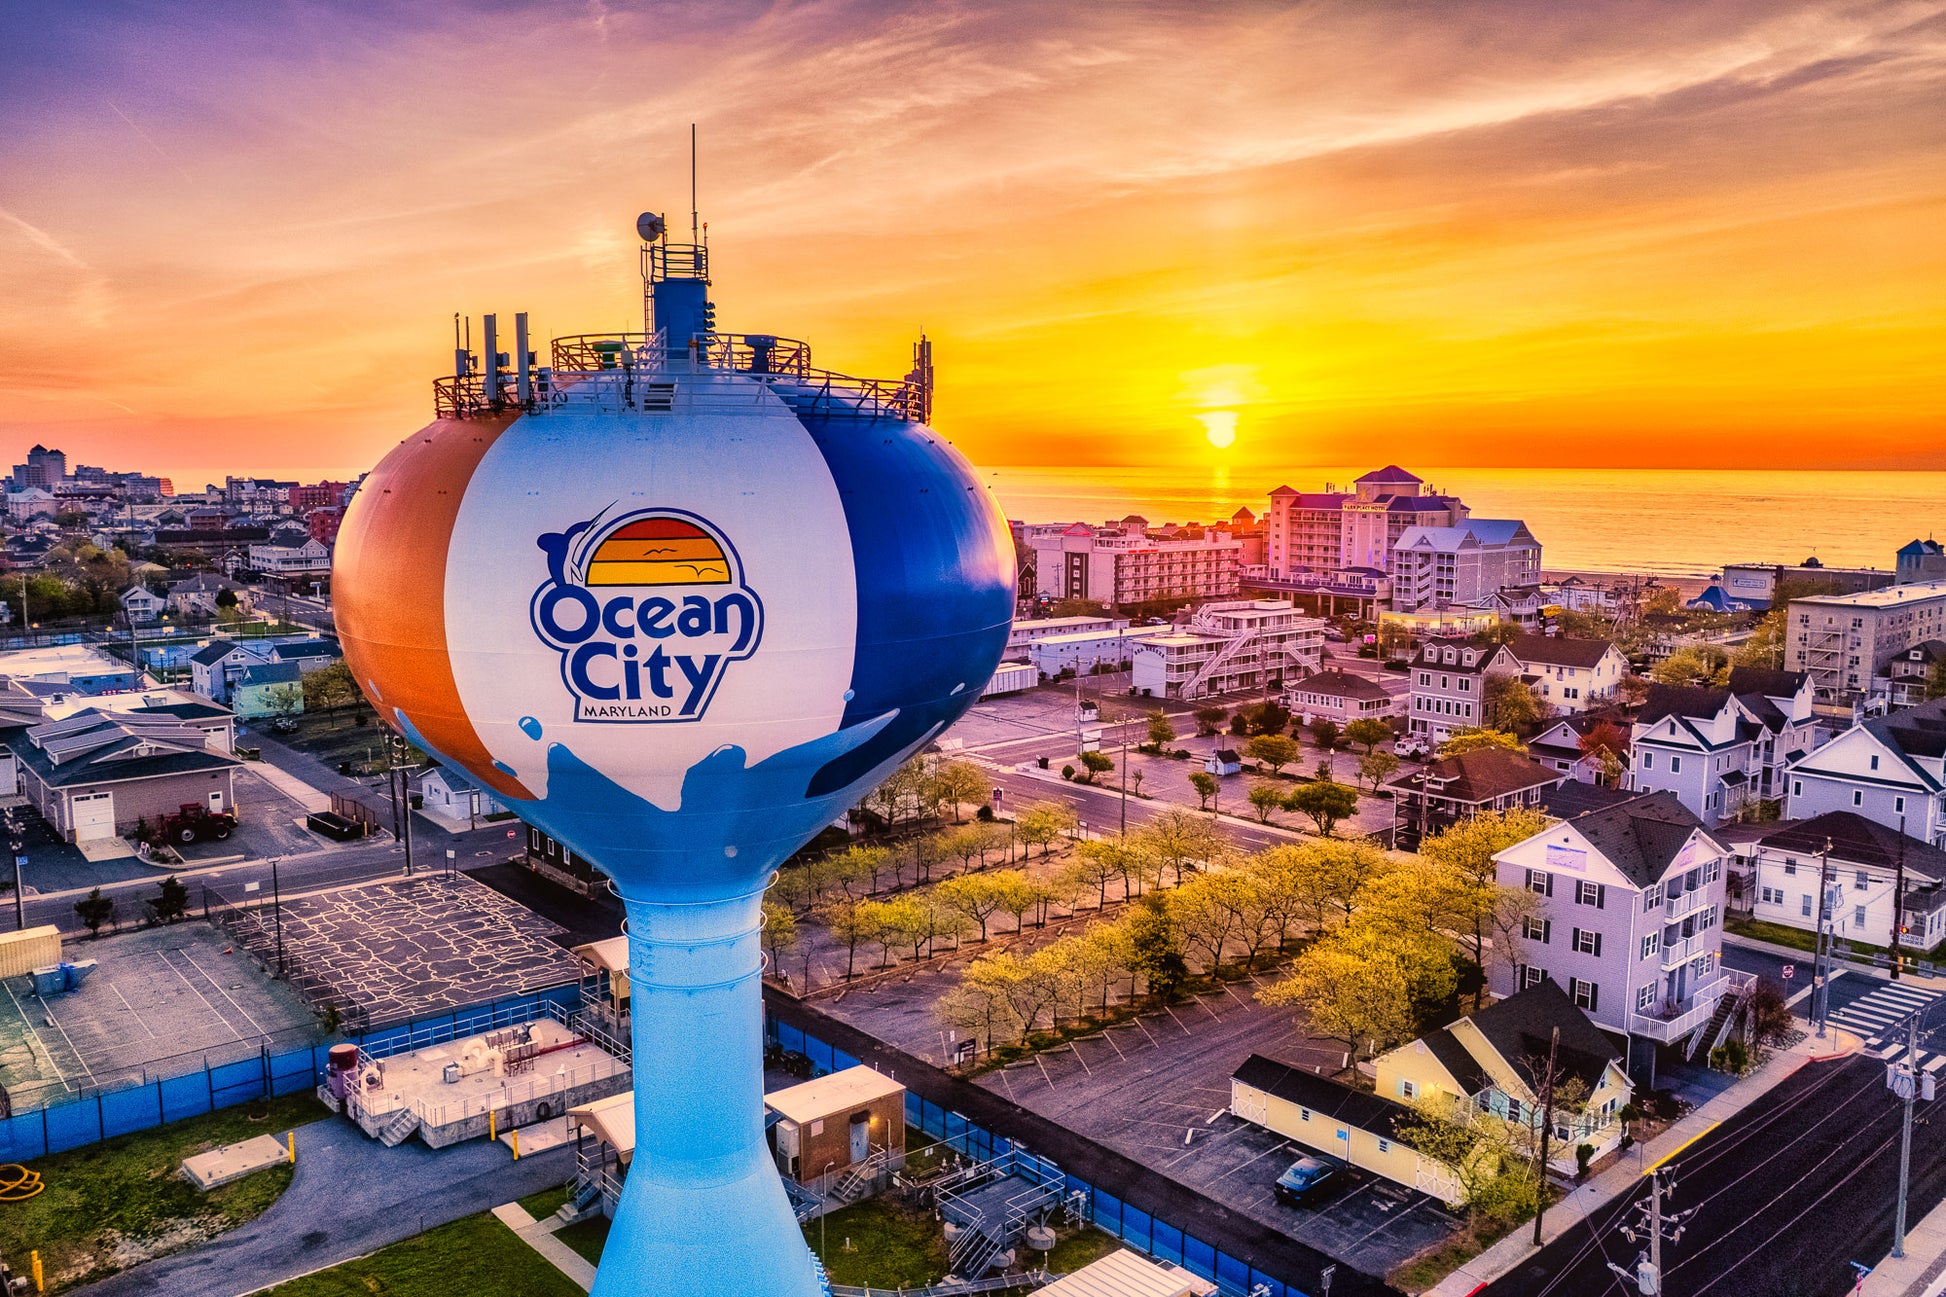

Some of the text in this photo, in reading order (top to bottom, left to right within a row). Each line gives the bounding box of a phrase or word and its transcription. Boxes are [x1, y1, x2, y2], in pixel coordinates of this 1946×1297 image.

[540, 584, 754, 651] Ocean
[571, 641, 722, 715] City
[584, 706, 671, 716] MARYLAND
